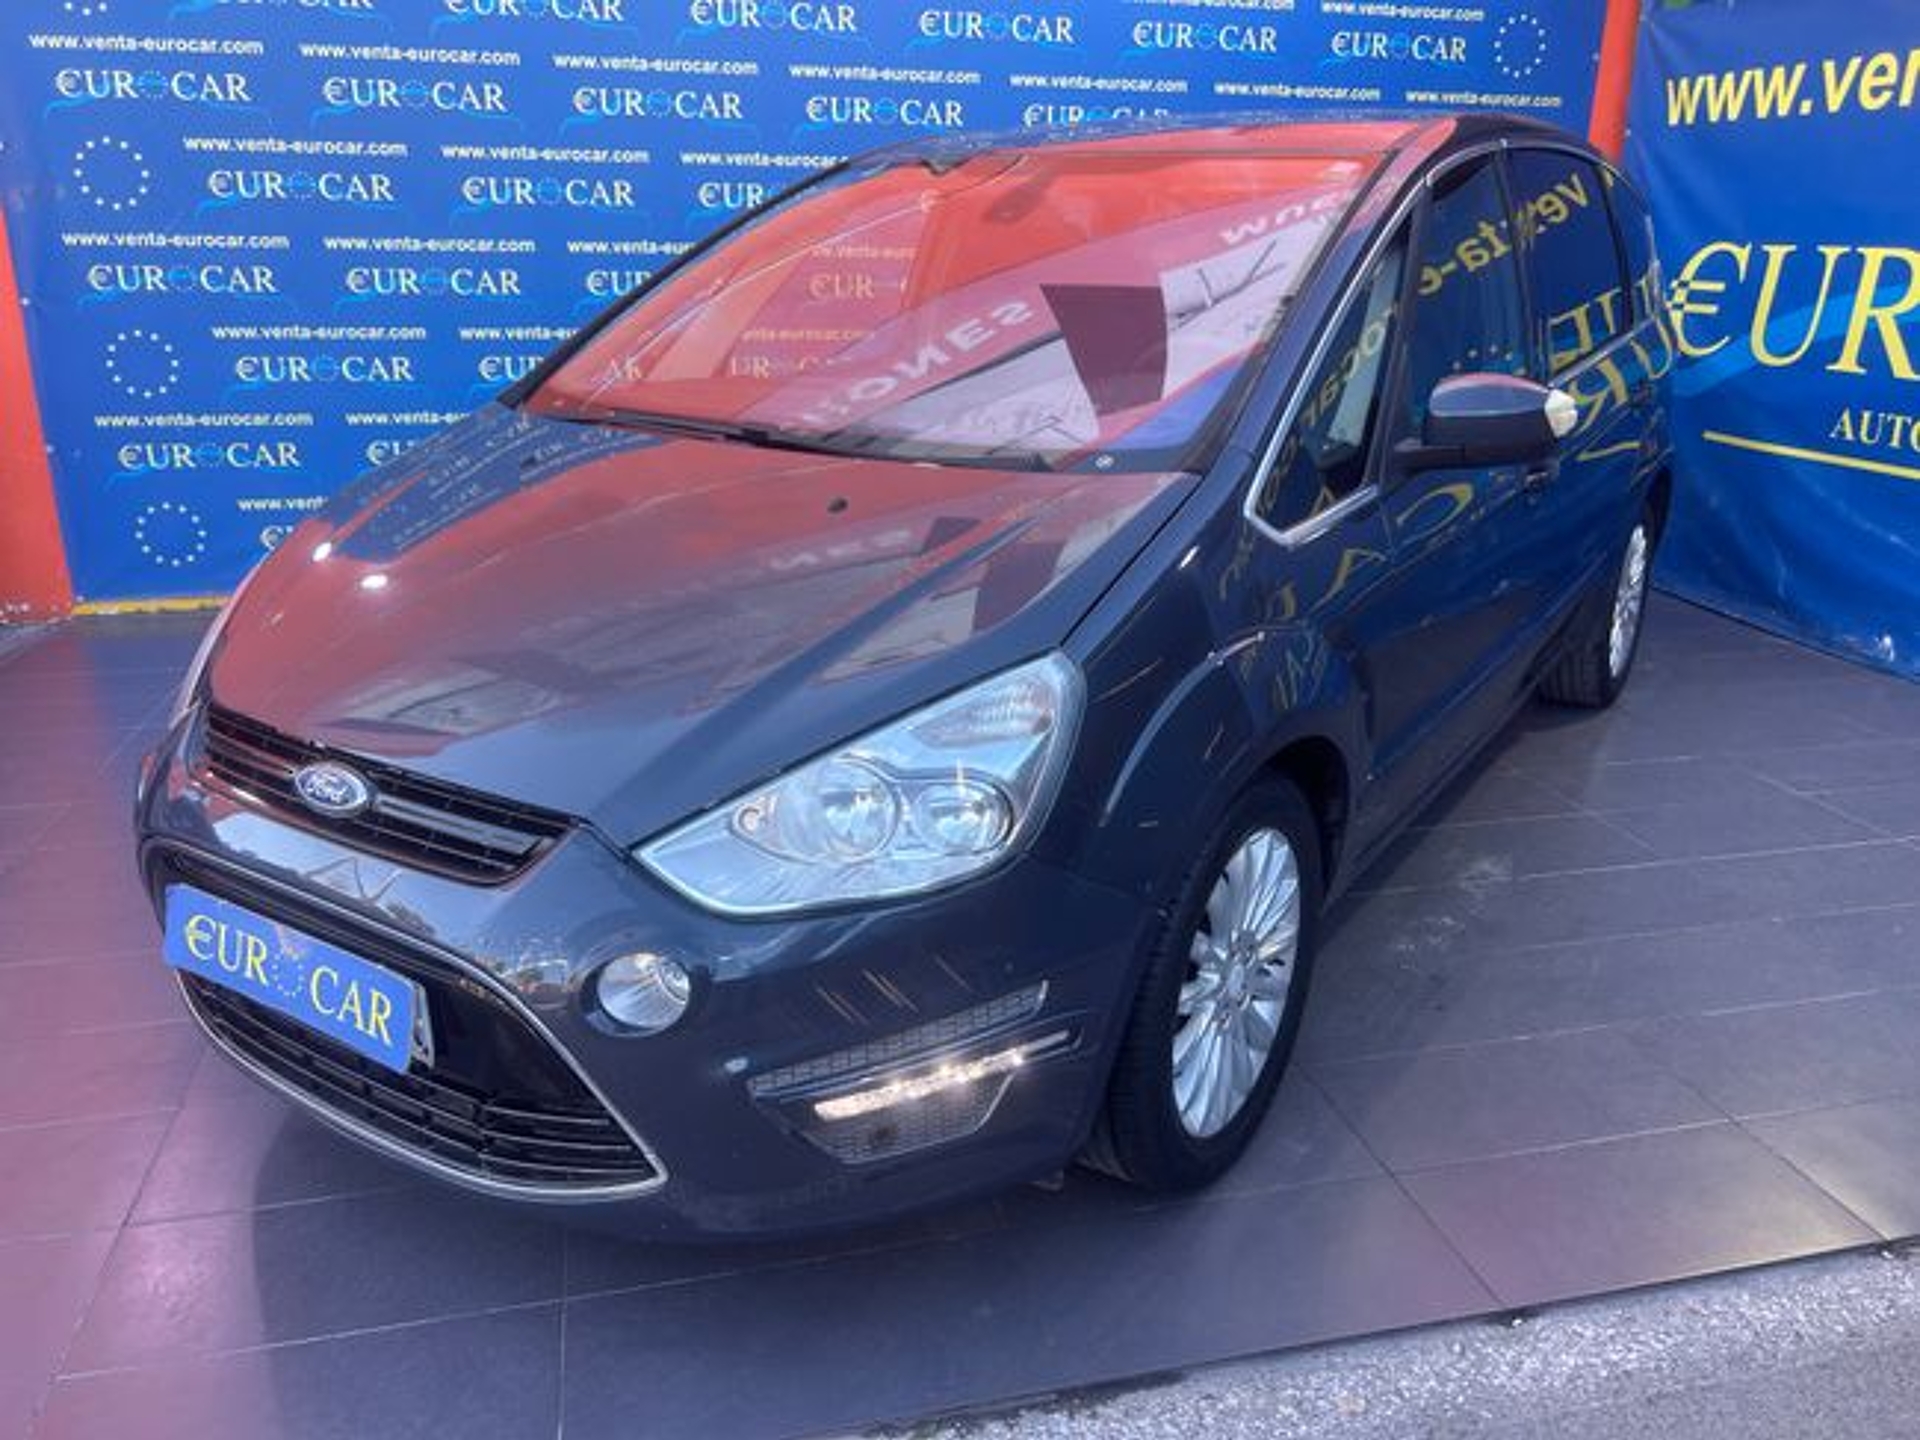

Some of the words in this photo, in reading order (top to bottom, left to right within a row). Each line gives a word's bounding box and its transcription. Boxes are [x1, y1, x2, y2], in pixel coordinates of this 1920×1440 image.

[1321, 2, 1485, 21] www.venta-eurocar.com
[28, 33, 264, 55] www.venta-eurocar.com
[300, 43, 521, 66] www.venta-eurocar.com
[552, 53, 759, 76] www.venta-eurocar.com
[789, 62, 981, 84] www.venta-eurocar.com
[1010, 74, 1188, 94] www.venta-eurocar.com
[1214, 80, 1381, 101] www.venta-eurocar.com
[183, 136, 408, 157] www.venta-eurocar.com
[441, 145, 650, 164] www.venta-eurocar.com
[61, 232, 290, 250] www.venta-eurocar.com
[323, 236, 535, 253] www.venta-eurocar.com
[211, 323, 427, 341] www.venta-eurocar.com
[95, 413, 314, 427] www.venta-eurocar.com
[304, 775, 348, 804] Ford
